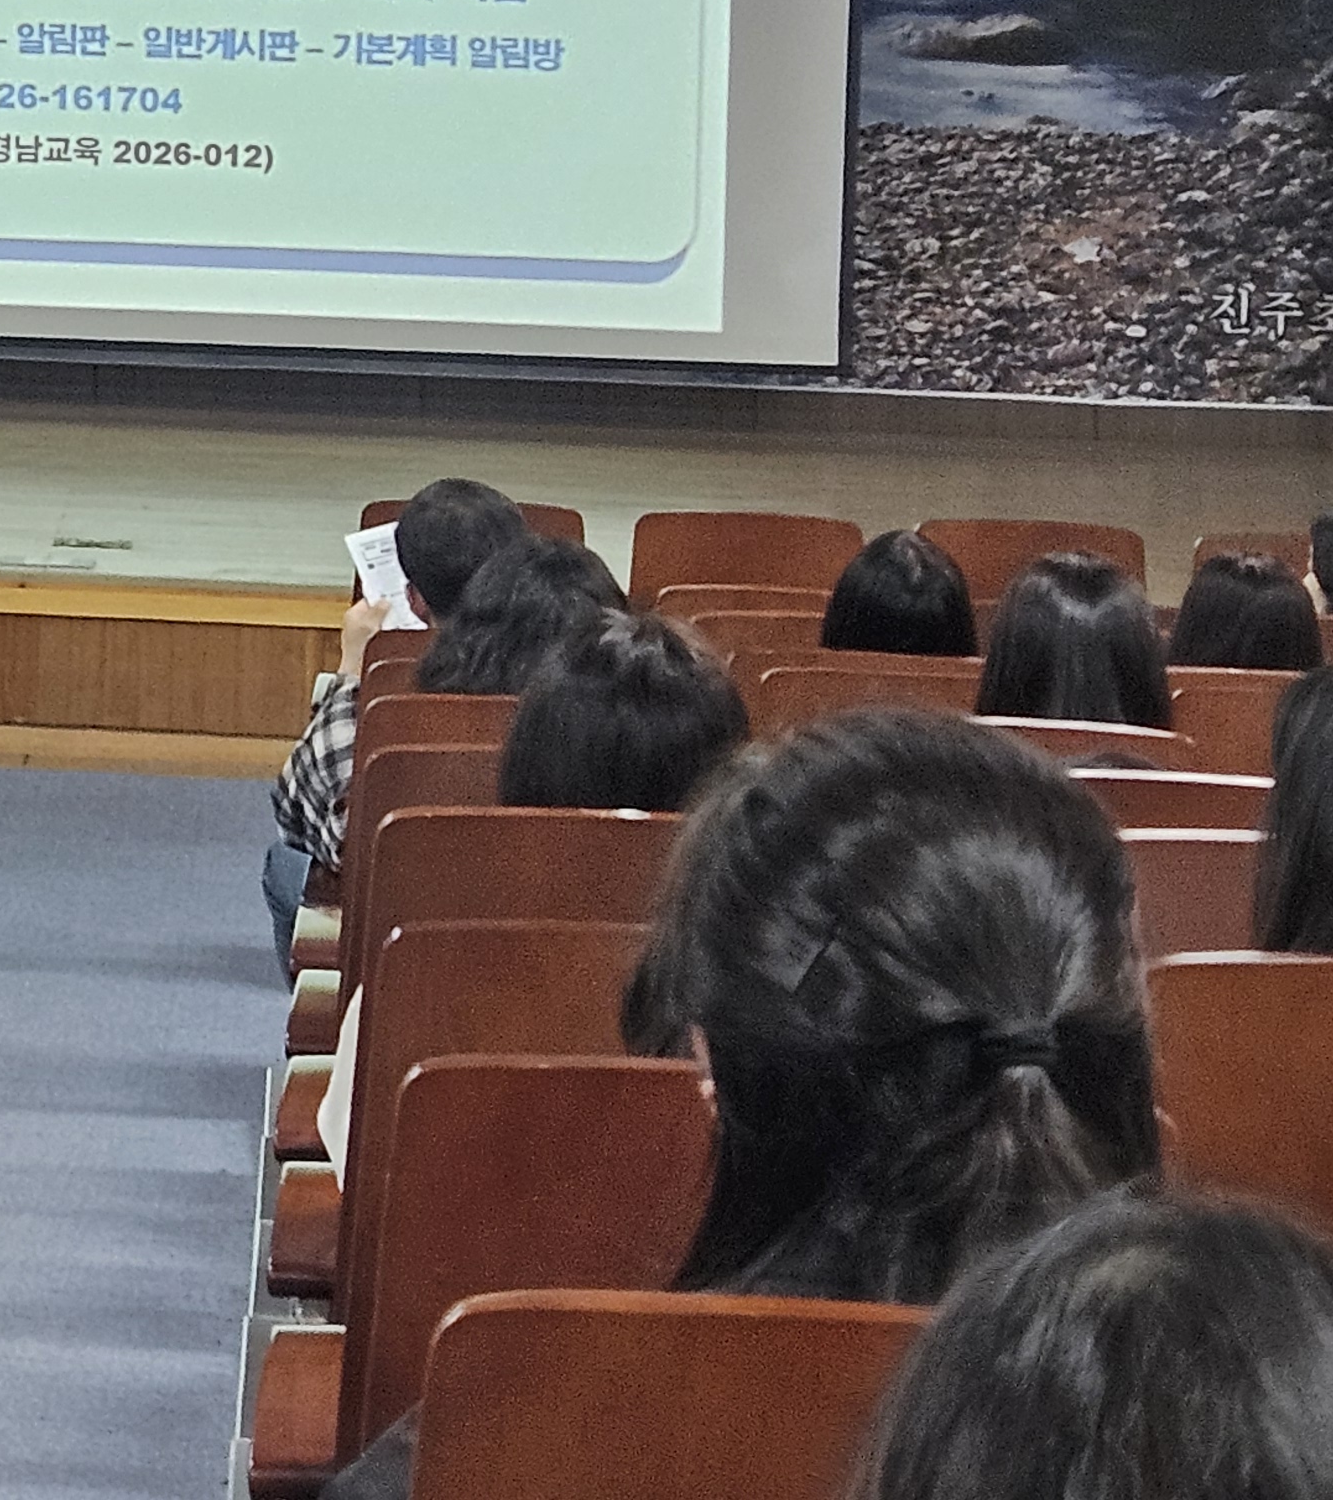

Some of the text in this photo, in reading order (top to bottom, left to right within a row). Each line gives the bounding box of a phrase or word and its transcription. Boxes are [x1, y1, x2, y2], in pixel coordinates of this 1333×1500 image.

[17, 22, 111, 57] 알림판
[143, 26, 300, 63] 일반게시판
[332, 31, 458, 67] 기본계획
[467, 35, 566, 72] 알림방
[112, 140, 274, 175] 2026-012)
